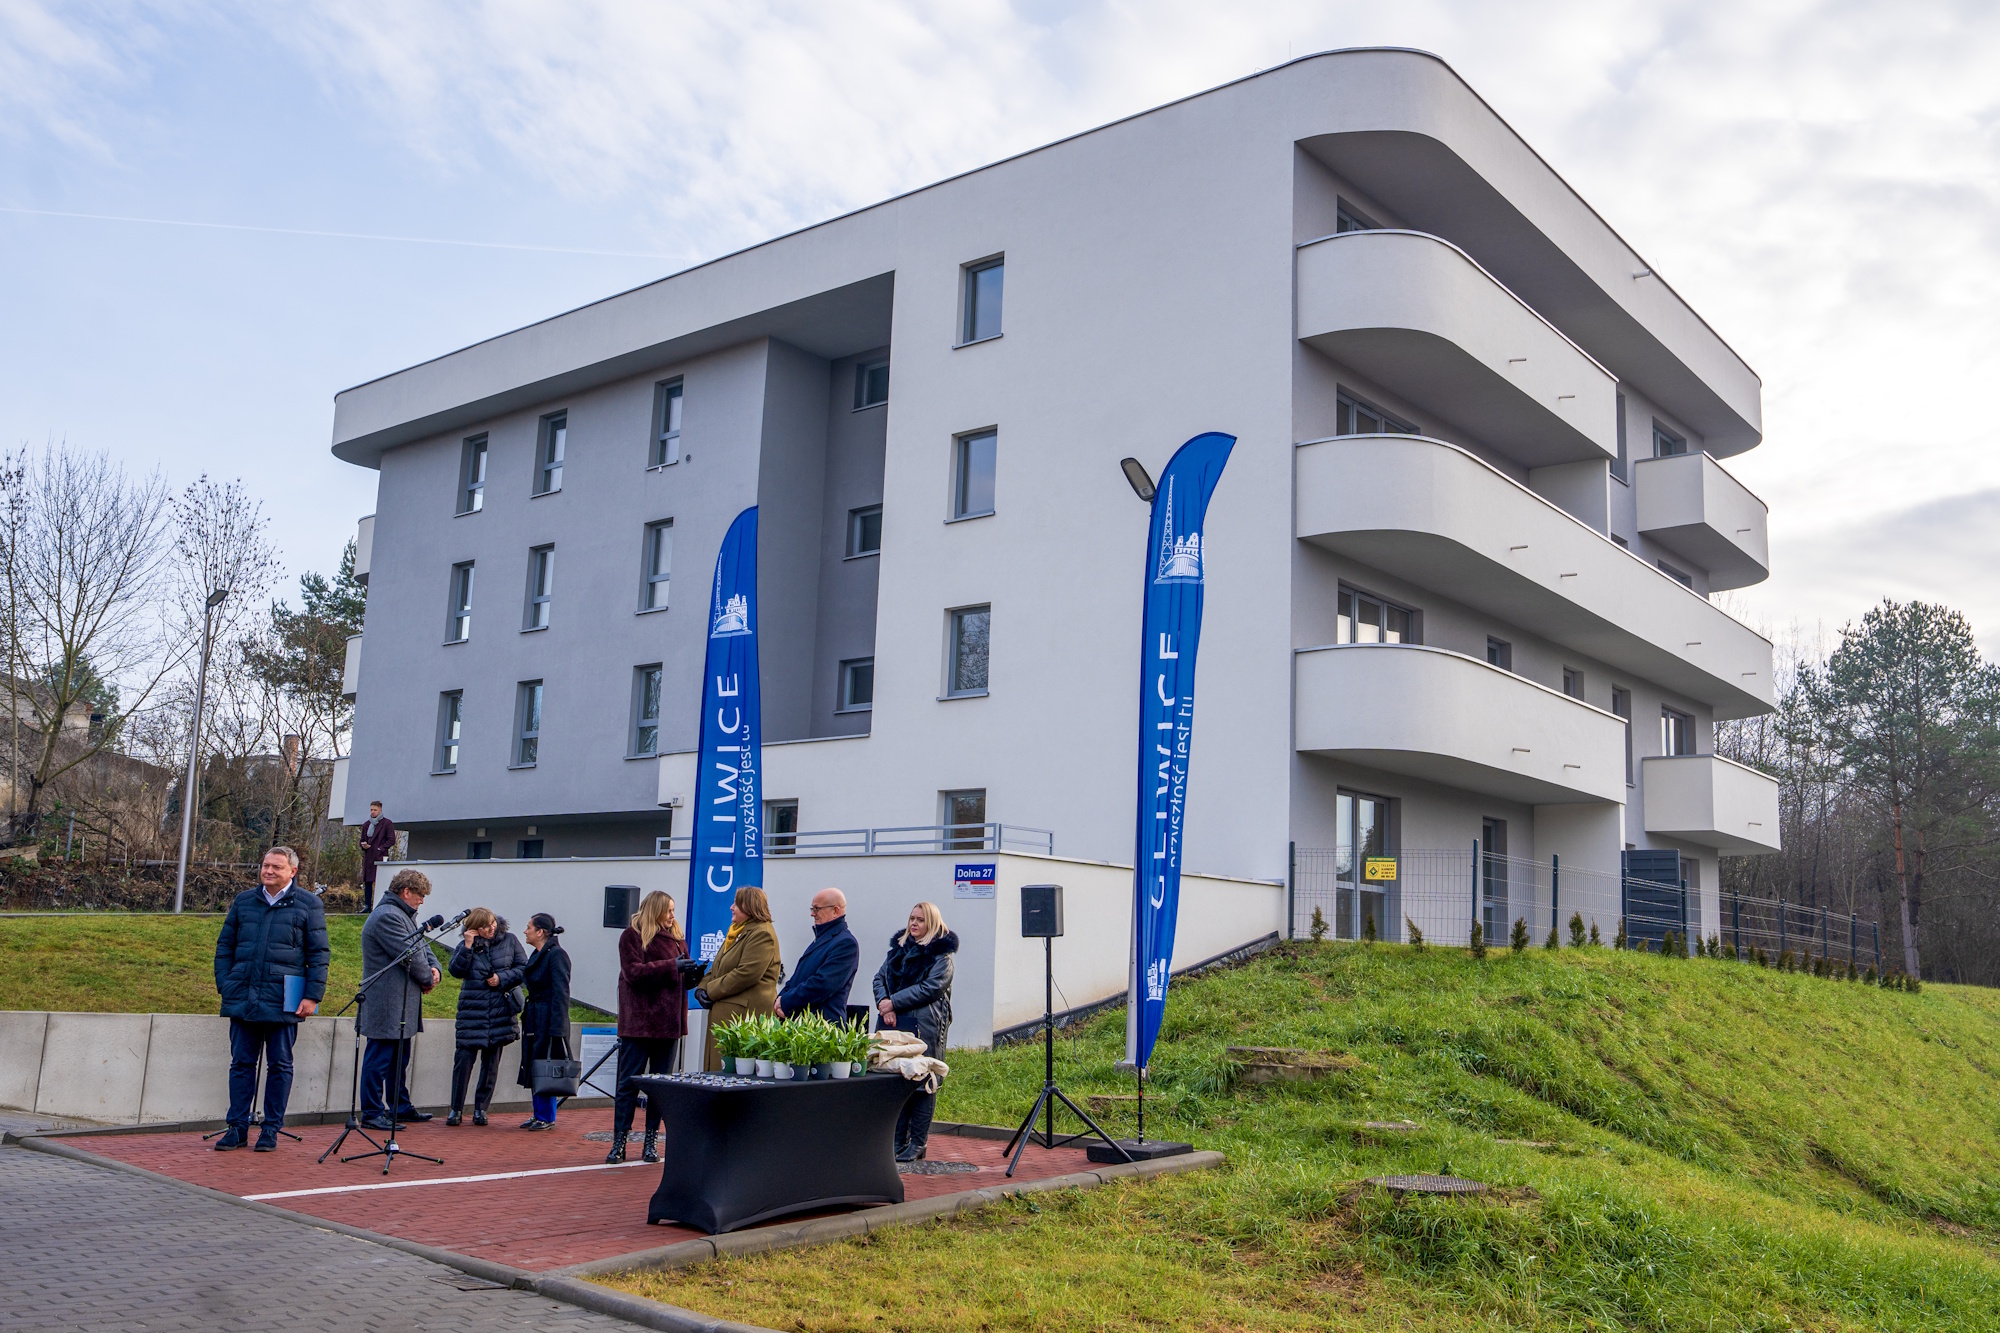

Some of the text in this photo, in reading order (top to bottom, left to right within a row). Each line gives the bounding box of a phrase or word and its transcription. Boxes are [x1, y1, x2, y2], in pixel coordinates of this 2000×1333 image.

[739, 744, 755, 774] jest
[707, 673, 741, 893] GLIWICE
[672, 797, 679, 805] 27
[738, 776, 759, 858] przyszłość
[957, 868, 993, 878] Dolna 27
